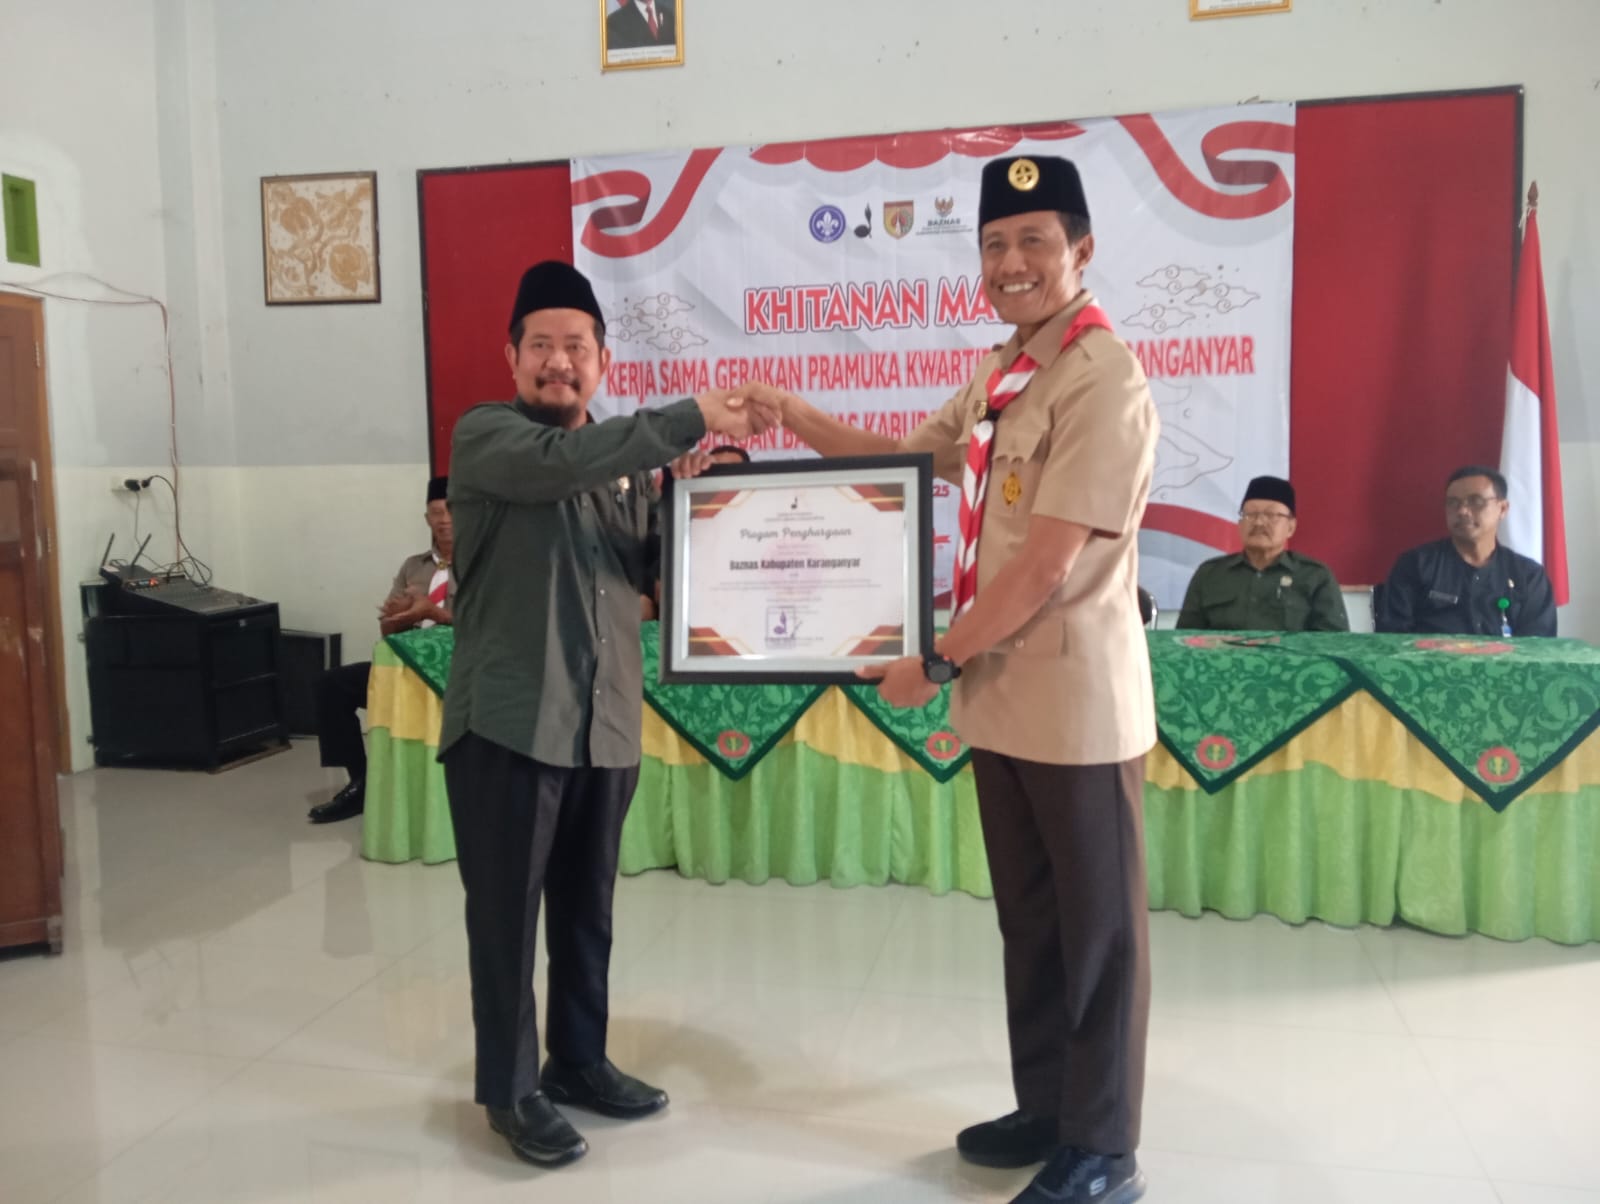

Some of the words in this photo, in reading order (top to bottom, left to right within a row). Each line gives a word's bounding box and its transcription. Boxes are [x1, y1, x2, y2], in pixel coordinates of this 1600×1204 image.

[745, 280, 928, 334] KHITANAN
[935, 275, 1003, 327] MA
[607, 361, 658, 404] KERJA
[659, 357, 711, 395] SAMA
[715, 355, 799, 393] GERAKAN
[808, 352, 901, 391] PRAMUKA
[1126, 335, 1255, 380] ANGANYAR
[933, 484, 951, 498] 25
[740, 528, 779, 542] Piagam
[782, 526, 852, 541] Penghargaan
[729, 560, 759, 571] Baznas
[761, 558, 805, 571] Kabupaten
[807, 557, 861, 570] Karanganyar
